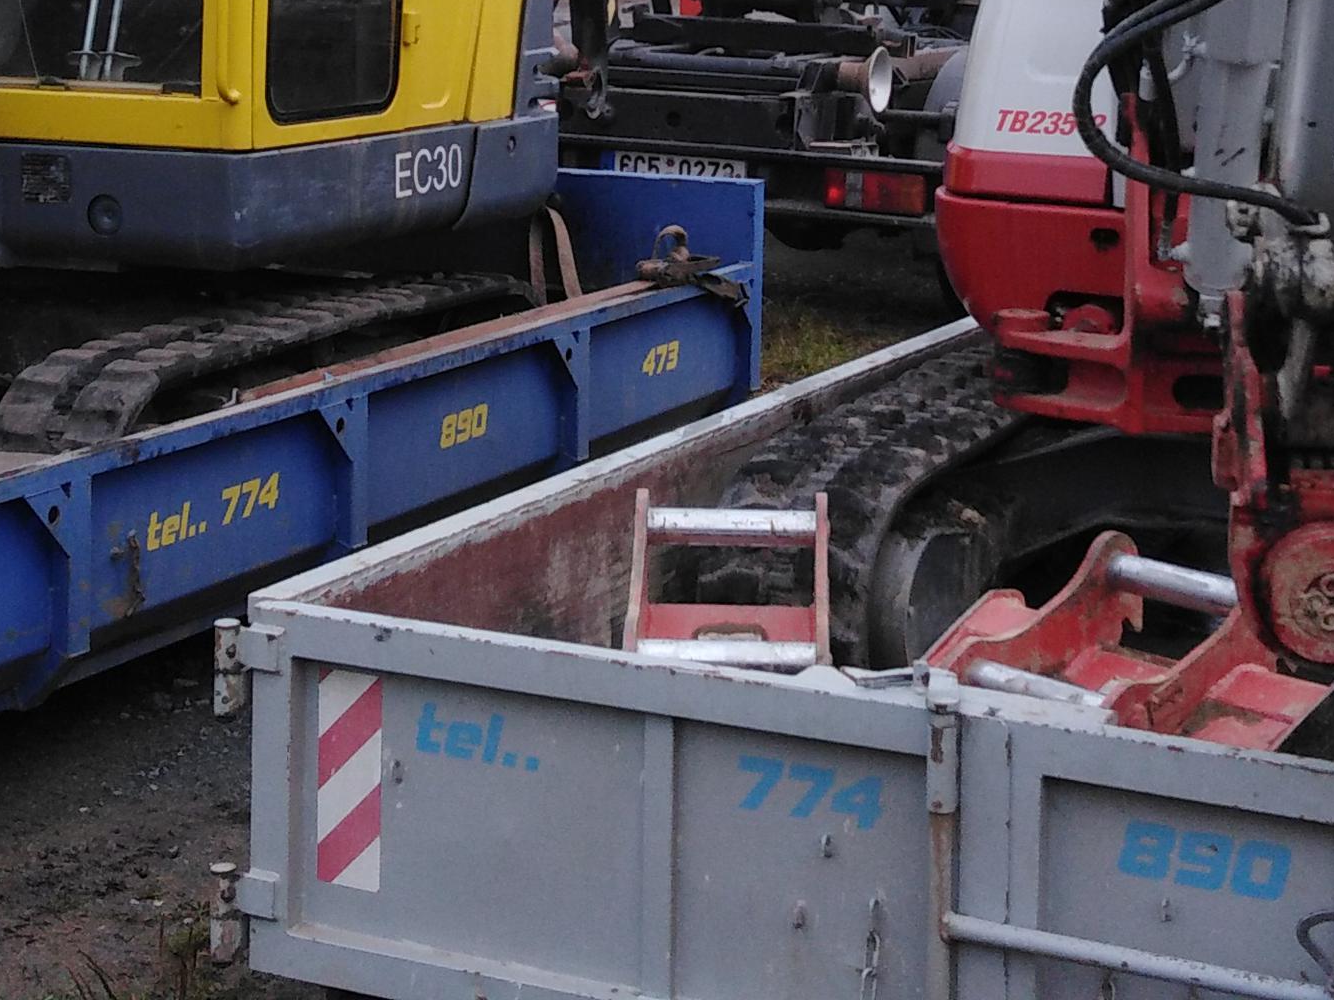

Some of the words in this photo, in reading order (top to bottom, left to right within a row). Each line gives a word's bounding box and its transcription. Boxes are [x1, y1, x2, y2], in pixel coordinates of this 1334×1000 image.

[395, 143, 463, 199] EC30
[221, 471, 281, 526] 774
[439, 402, 489, 449] 890
[641, 339, 680, 377] 473
[415, 701, 541, 773] tel..
[736, 753, 885, 832] 774
[1117, 819, 1293, 901] 890
